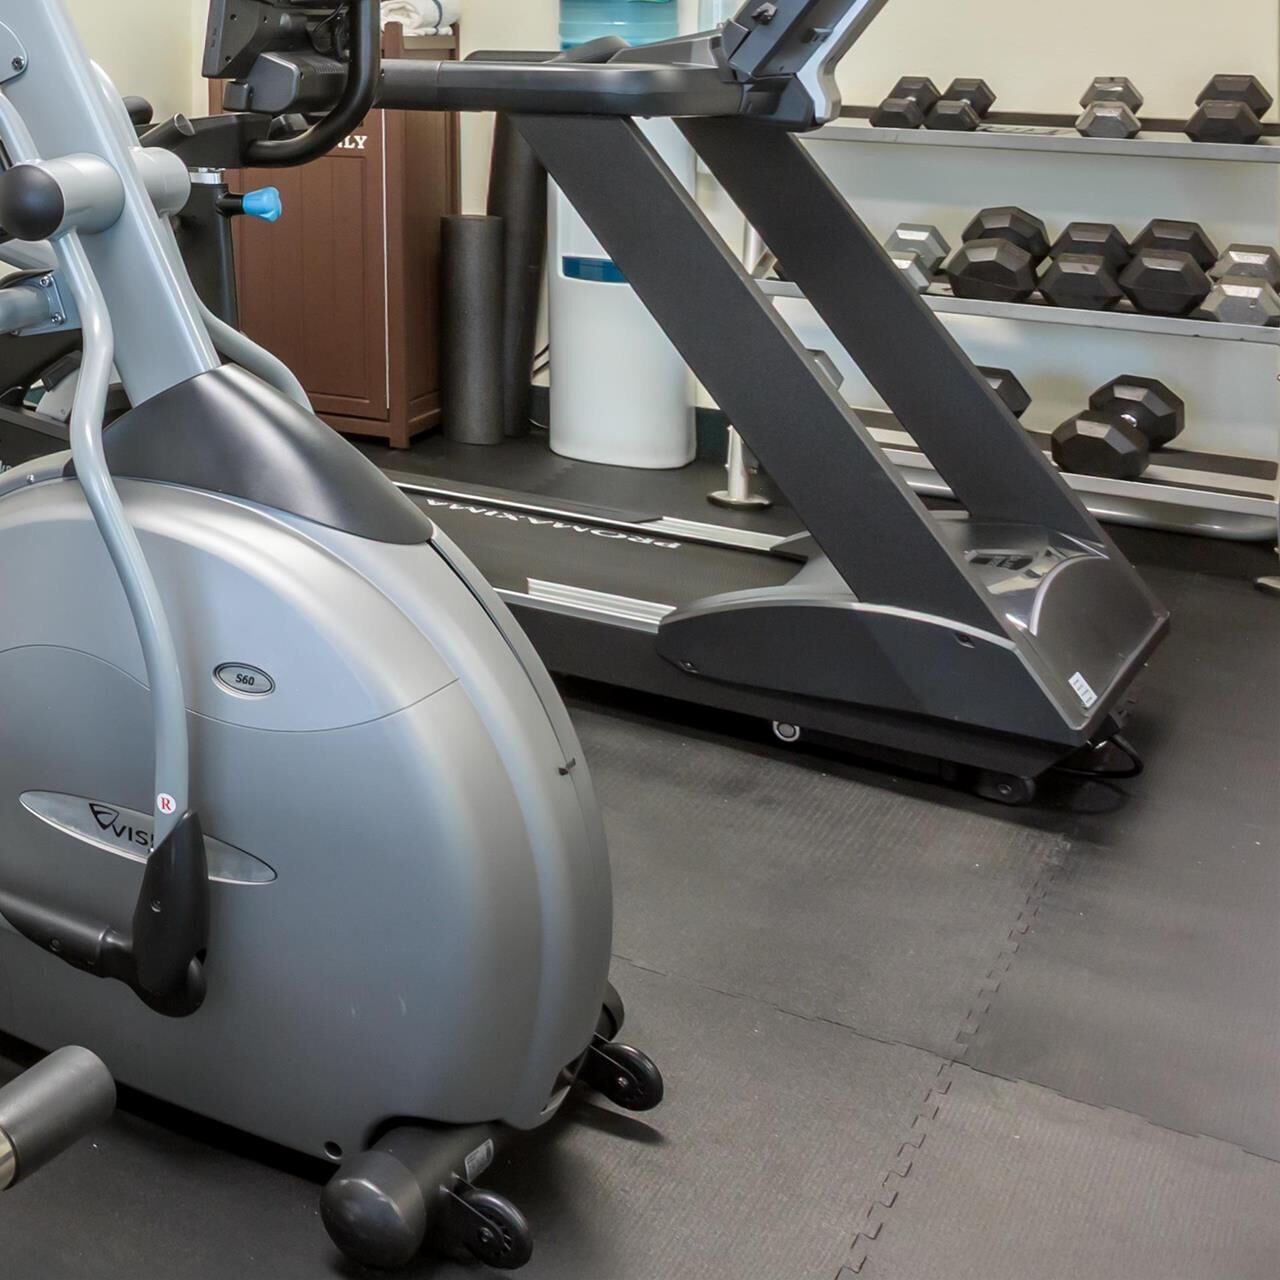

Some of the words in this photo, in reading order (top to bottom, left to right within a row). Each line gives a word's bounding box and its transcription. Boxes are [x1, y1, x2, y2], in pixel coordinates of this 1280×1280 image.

[427, 499, 681, 549] PROMAXIMA
[235, 673, 255, 686] S60
[160, 797, 172, 811] R
